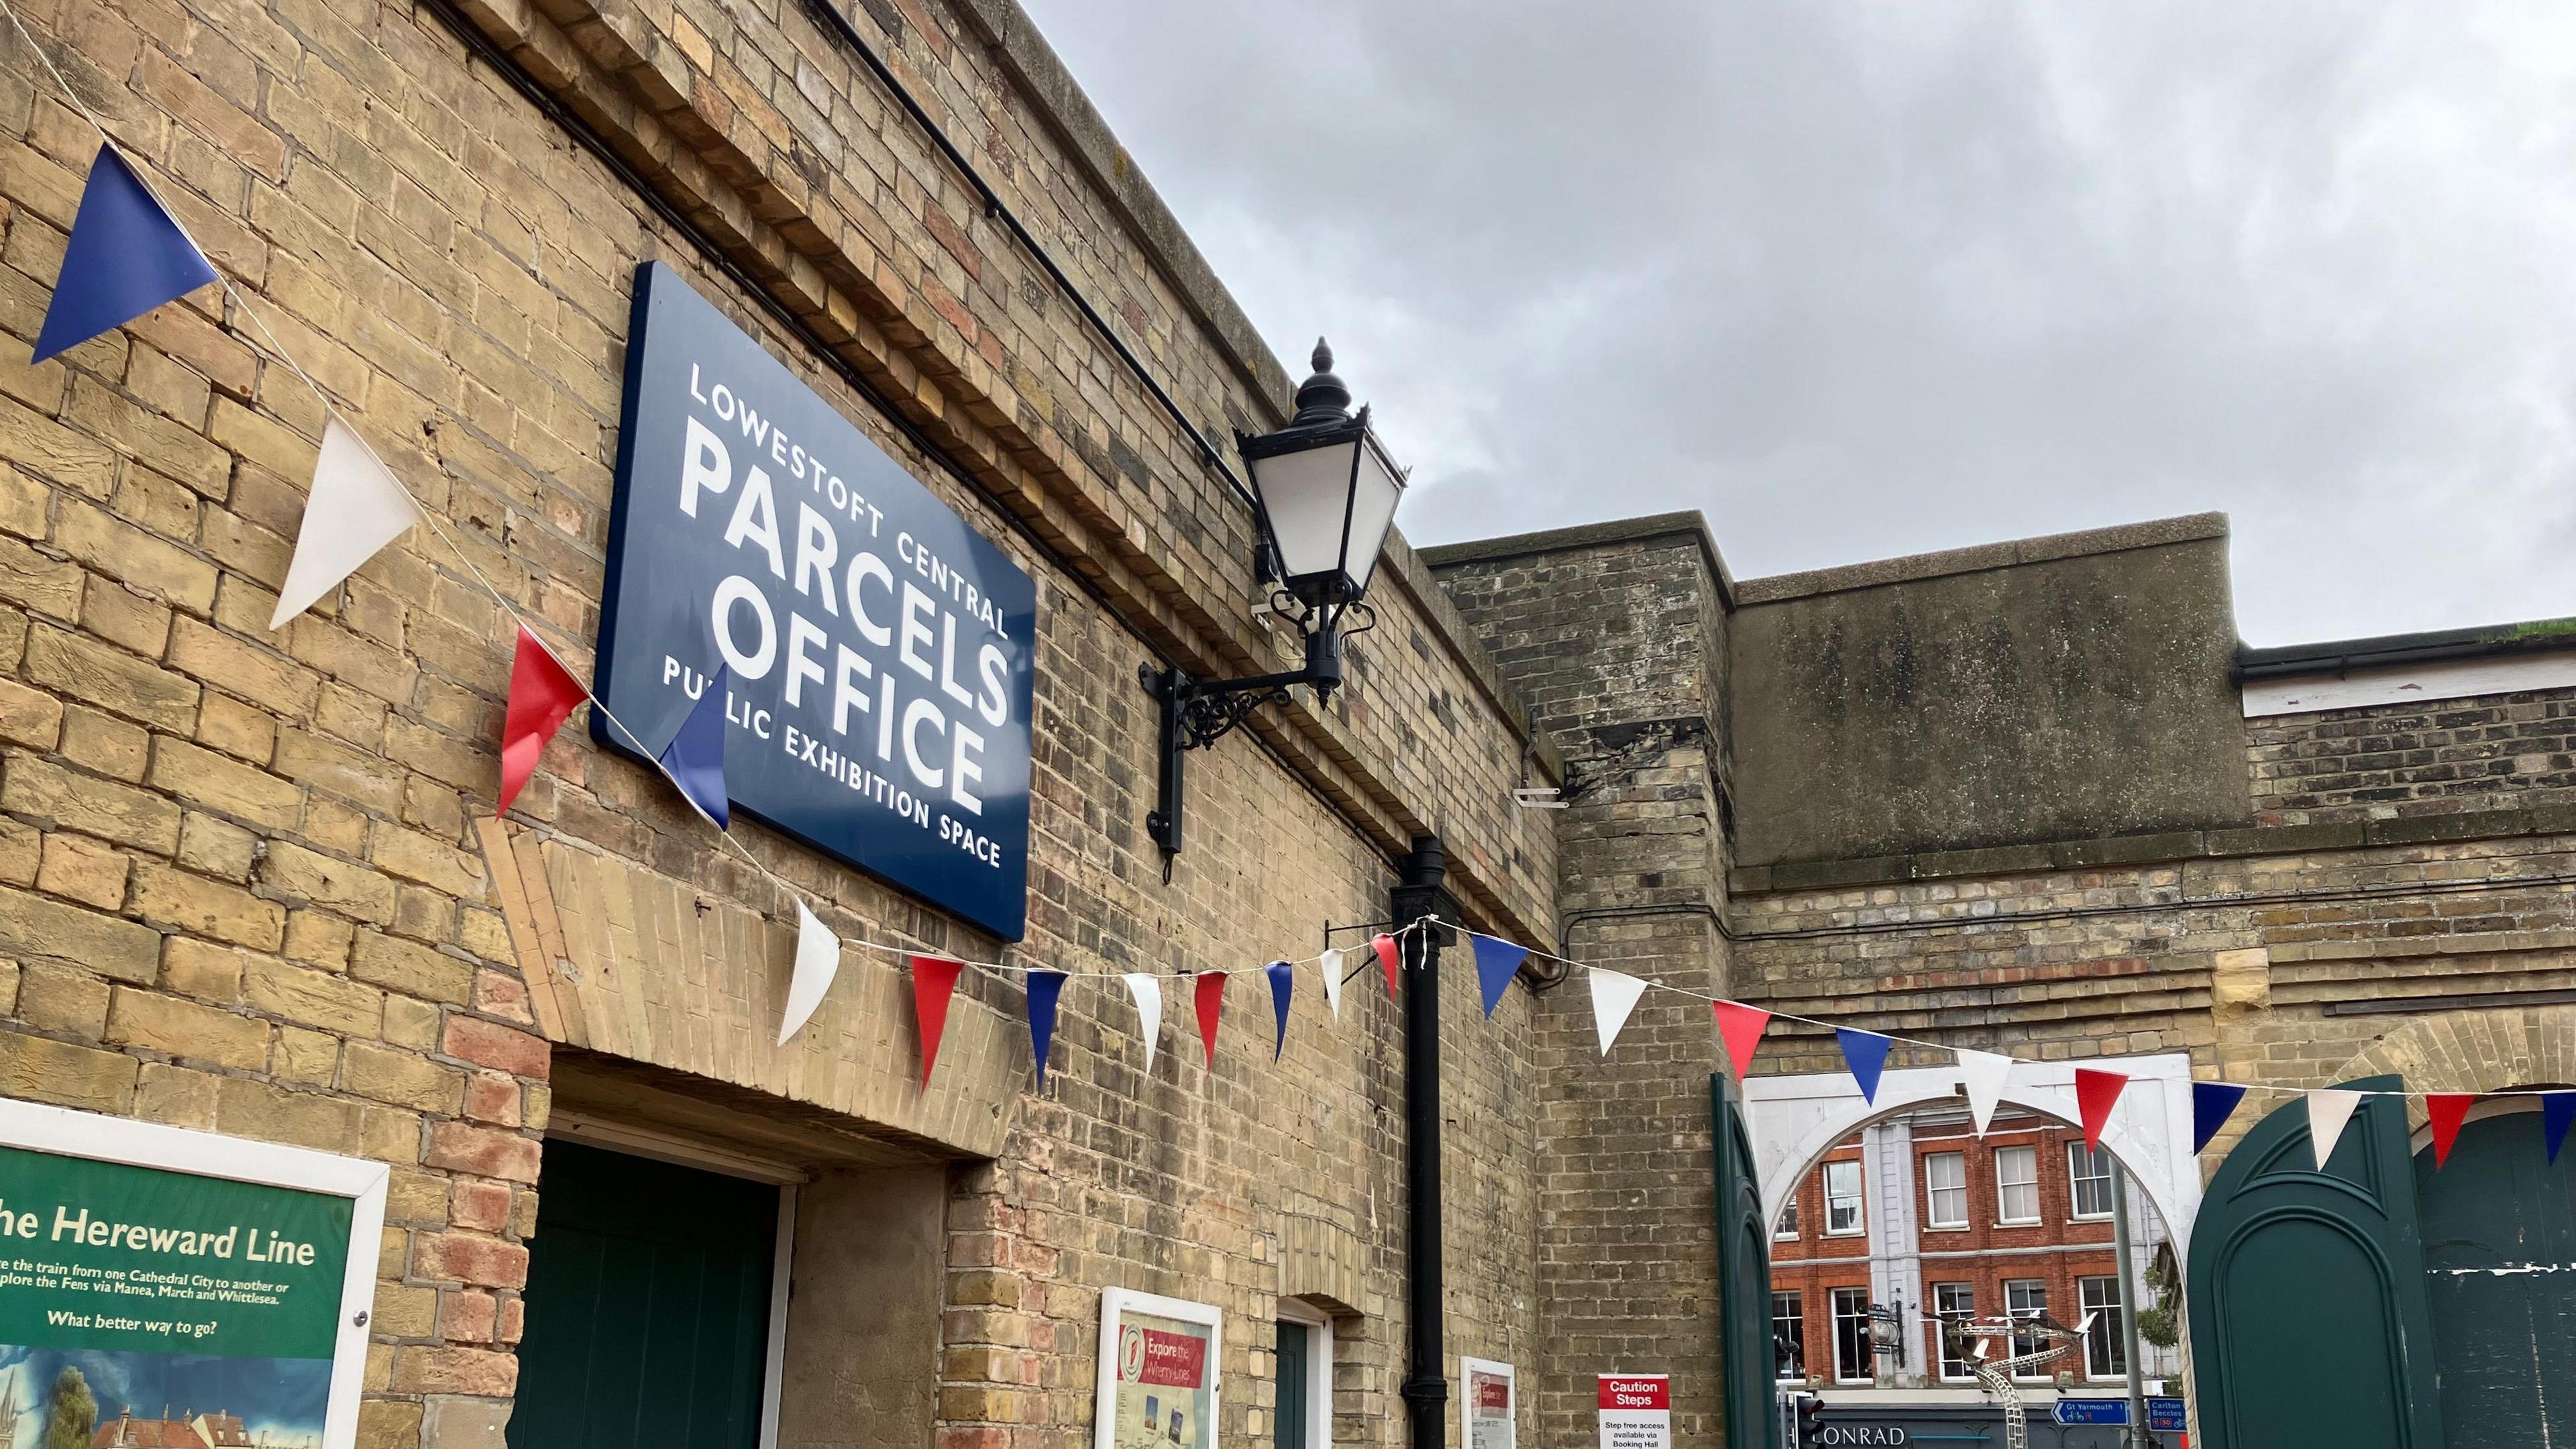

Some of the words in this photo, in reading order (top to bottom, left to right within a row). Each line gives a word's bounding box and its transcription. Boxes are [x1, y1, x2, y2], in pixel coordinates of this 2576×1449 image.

[691, 362, 884, 538] LOWESTOFT
[898, 531, 1008, 640] CENTRAL
[680, 415, 1008, 727] PARCELS
[712, 575, 984, 816] OFFICE
[663, 655, 771, 739] PULIC
[785, 725, 929, 828] EXHIBITION
[940, 814, 1000, 868] SPACE
[0, 1199, 38, 1238] he
[52, 1205, 237, 1258] Hereward
[247, 1228, 315, 1266] Line
[0, 1272, 33, 1287] plore
[36, 1275, 57, 1288] the
[62, 1277, 89, 1291] Fens
[93, 1281, 111, 1293] via
[115, 1282, 155, 1298] Manea,
[158, 1285, 194, 1299] March
[196, 1290, 215, 1301] and
[217, 1290, 280, 1305] Whittlesea.
[13, 1259, 33, 1272] the
[36, 1263, 68, 1275] train
[72, 1265, 101, 1279] from
[105, 1270, 125, 1280] one
[129, 1270, 189, 1286] Cathedral
[192, 1275, 214, 1290] City
[216, 1279, 229, 1289] to
[233, 1280, 273, 1292] another
[276, 1284, 289, 1293] or
[48, 1310, 91, 1327] What
[95, 1314, 142, 1330] better
[145, 1321, 173, 1336] way
[176, 1321, 191, 1333] to
[195, 1322, 217, 1338] go?
[1148, 1338, 1177, 1359] Explore
[1177, 1343, 1189, 1358] the
[1175, 1364, 1190, 1381] Lines
[1609, 1381, 1658, 1393] Caution
[1616, 1394, 1652, 1407] Steps
[1613, 1441, 1643, 1449] Booking
[1823, 1427, 1904, 1445] ONRAD
